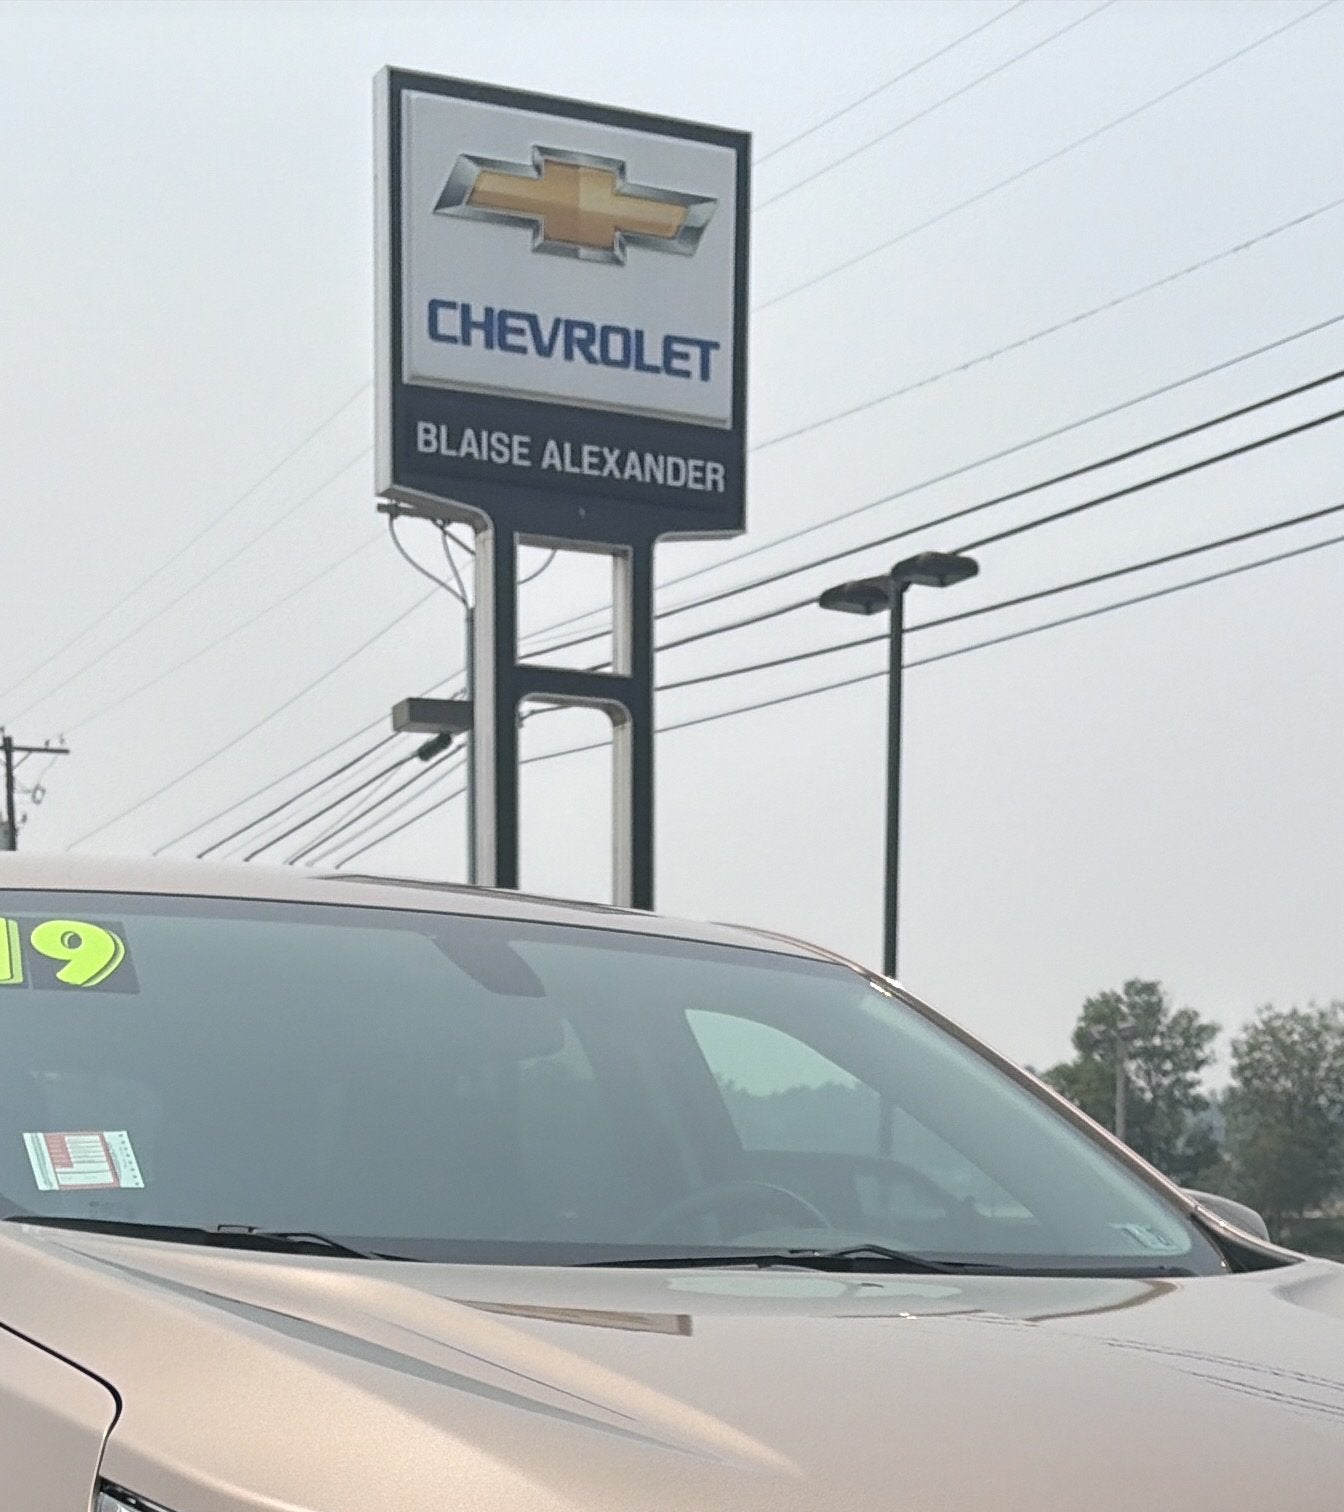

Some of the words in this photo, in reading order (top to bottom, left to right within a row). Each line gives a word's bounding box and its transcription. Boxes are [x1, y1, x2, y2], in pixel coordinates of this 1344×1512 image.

[427, 298, 720, 382] CHEVROLET
[417, 421, 531, 467] BLAISE
[541, 439, 725, 493] ALEXANDER
